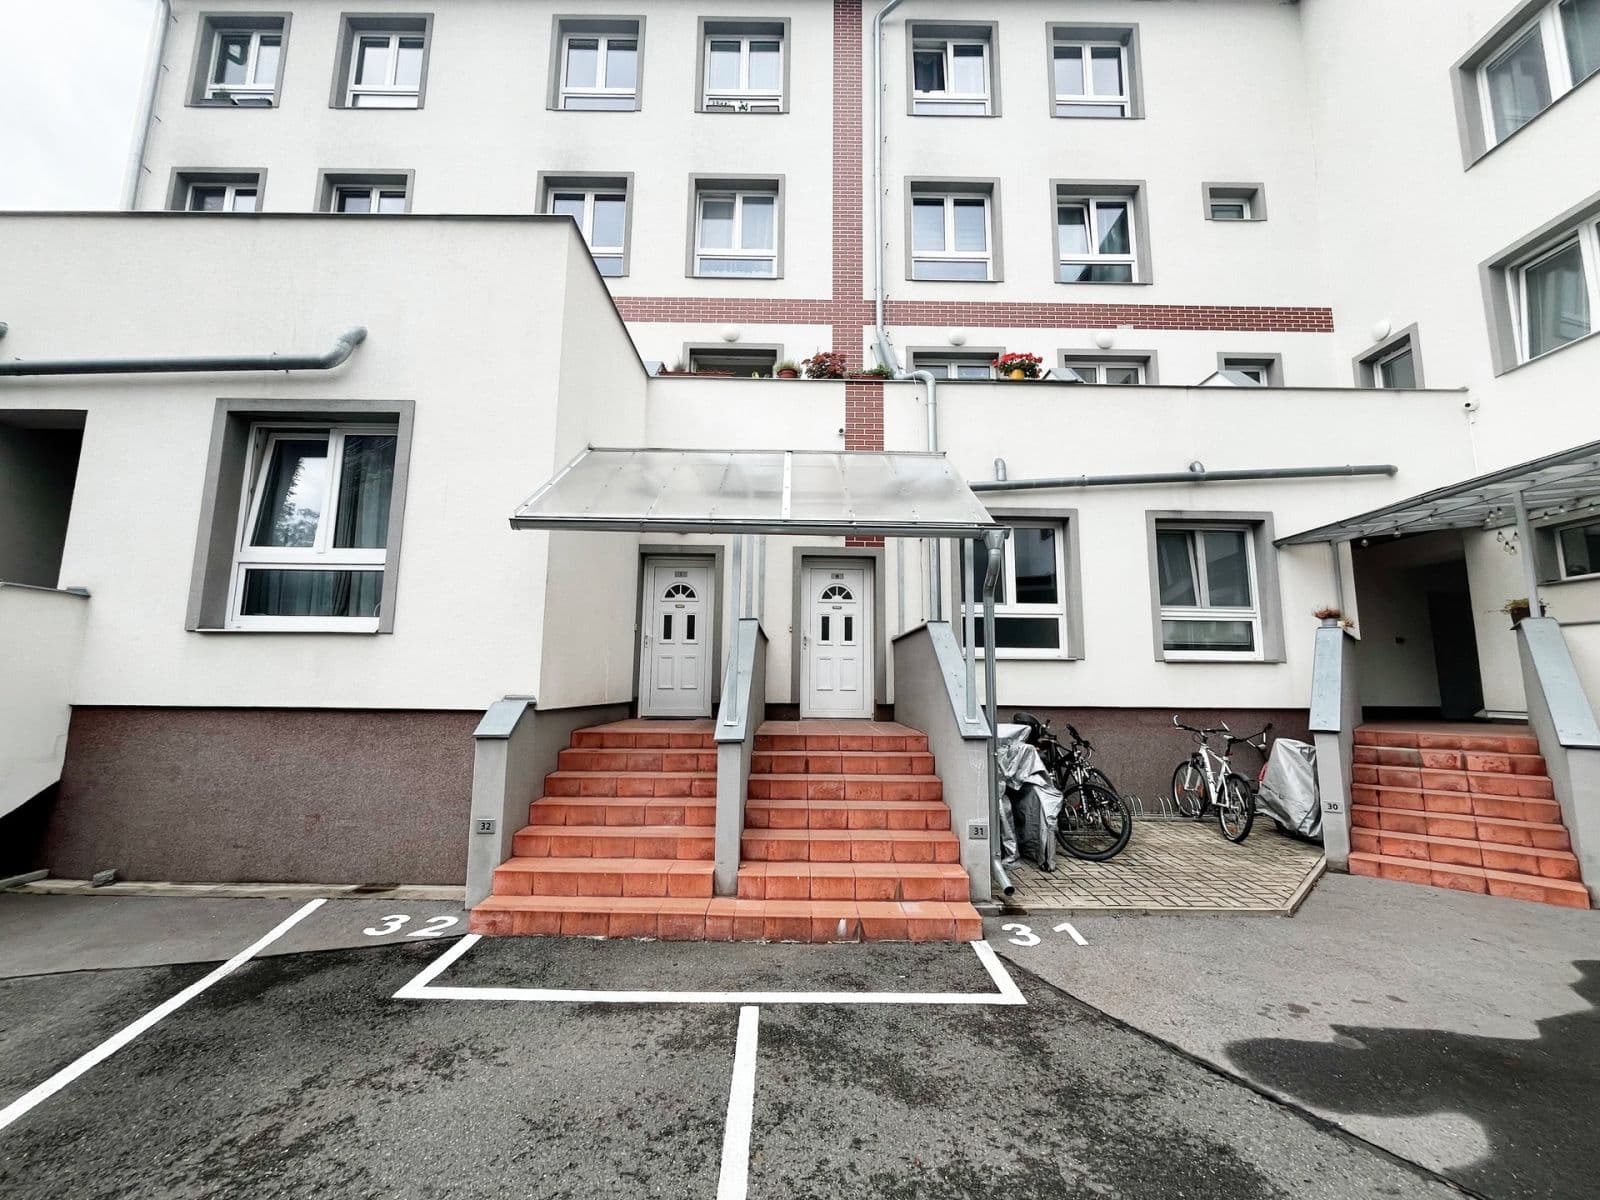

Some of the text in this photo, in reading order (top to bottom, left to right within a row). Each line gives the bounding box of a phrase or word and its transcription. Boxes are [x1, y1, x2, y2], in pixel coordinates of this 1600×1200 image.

[1327, 802, 1338, 810] 30
[480, 822, 491, 831] 32
[974, 827, 984, 836] 31
[363, 914, 459, 937] 32
[1001, 923, 1089, 947] 31
